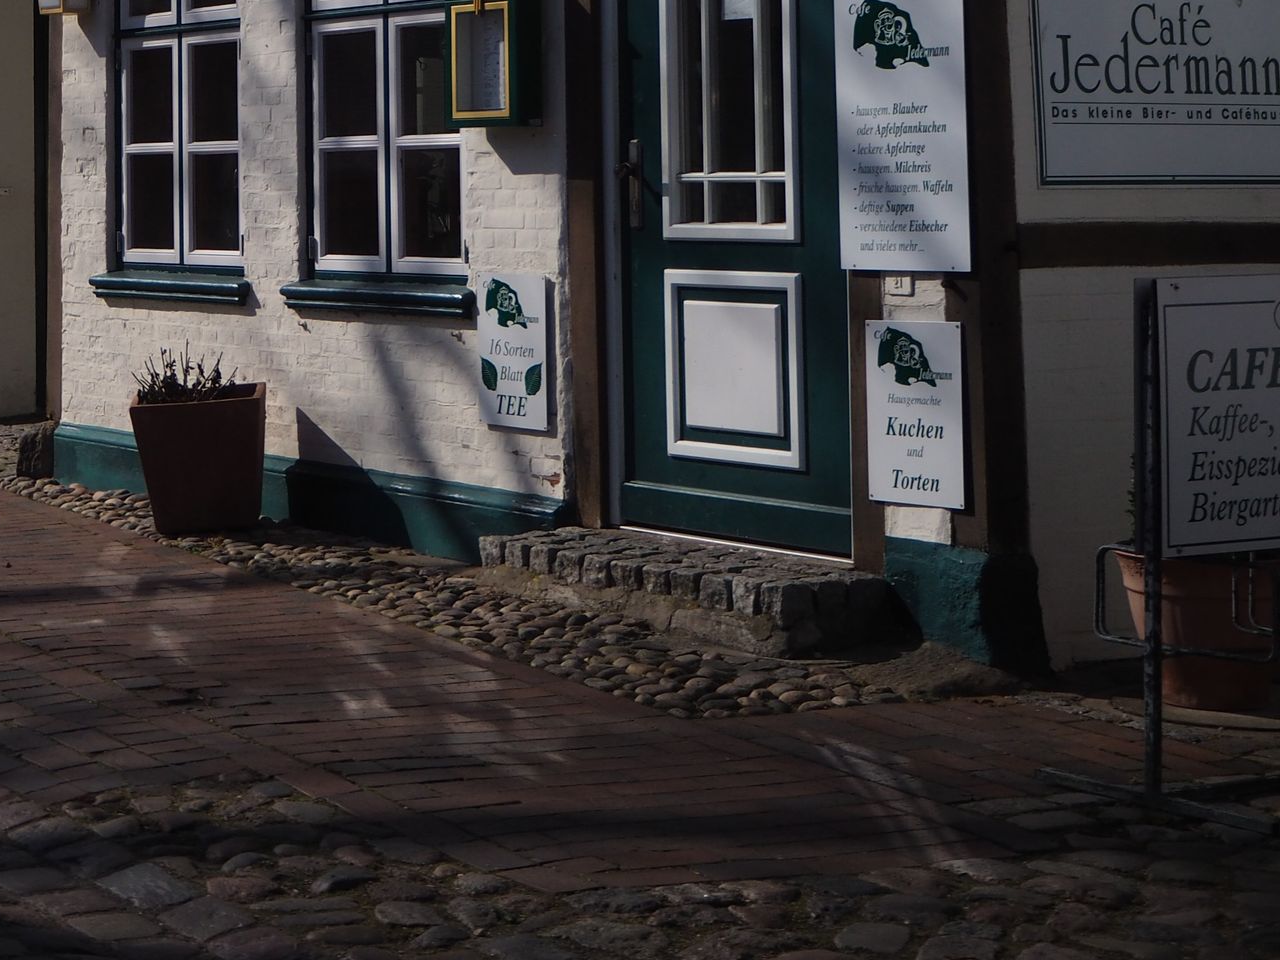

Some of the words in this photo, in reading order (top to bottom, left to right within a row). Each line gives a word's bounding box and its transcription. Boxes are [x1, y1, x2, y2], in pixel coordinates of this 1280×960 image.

[1130, 2, 1212, 47] Café
[905, 43, 950, 61] Jedermann
[1049, 31, 1280, 96] Jedermann
[856, 105, 891, 118] hausgem.
[892, 101, 928, 115] Blaubeer
[1051, 105, 1078, 120] Das
[1088, 105, 1133, 120] kleine
[1142, 105, 1176, 120] Bier-
[1187, 106, 1212, 121] und
[1221, 107, 1280, 121] Caféhau
[856, 123, 874, 136] oder
[875, 120, 947, 138] Apfelpfannkuchen
[857, 142, 883, 155] leckere
[884, 141, 926, 158] Apfelringe
[894, 160, 931, 174] Milchreis
[922, 179, 953, 195] Waffeln
[858, 200, 884, 216] deftige
[885, 200, 915, 216] Suppen
[859, 220, 907, 232] verschiedene
[909, 219, 948, 232] Eisbecher
[860, 240, 874, 251] und
[876, 240, 897, 251] vieles
[489, 338, 502, 355] 16
[503, 341, 534, 358] Sorten
[500, 365, 523, 382] Blatt
[496, 394, 528, 417] TEE
[887, 392, 942, 407] Hausgemachte
[886, 416, 945, 440] Kuchen
[1187, 403, 1275, 442] Kaffee-,
[906, 446, 924, 458] und
[1187, 446, 1280, 486] Eisspezi
[891, 468, 940, 492] Torten
[1188, 491, 1280, 527] Biergart
